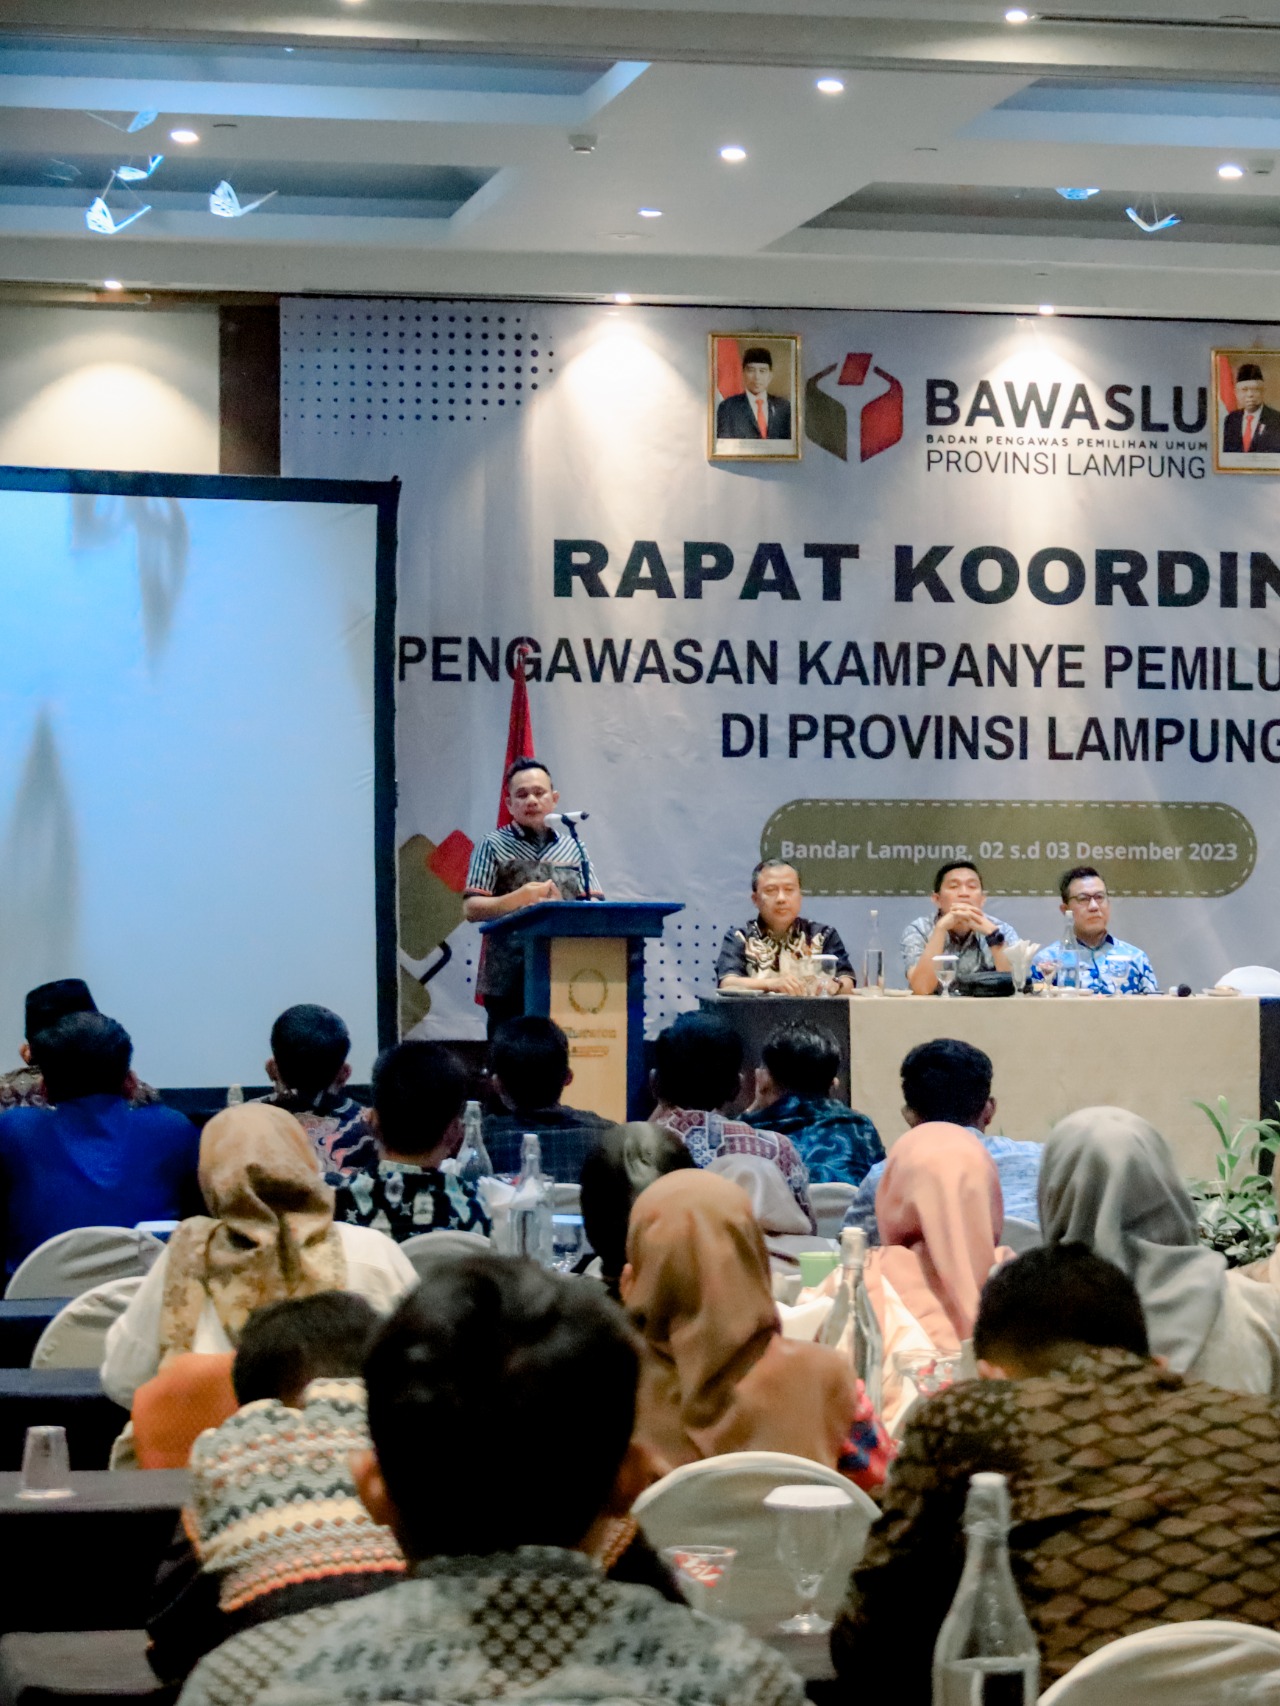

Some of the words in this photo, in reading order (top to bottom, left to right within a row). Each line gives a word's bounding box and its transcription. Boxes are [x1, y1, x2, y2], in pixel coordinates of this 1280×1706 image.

[926, 378, 1208, 433] BAWASLU
[926, 434, 977, 444] BADAN
[986, 436, 1069, 448] PENGAWAS
[1077, 438, 1158, 450] PEMILIHAN
[1165, 441, 1208, 452] UMUM
[926, 450, 1057, 475] PROVINSI
[1067, 453, 1206, 480] LAMPUNG
[553, 538, 860, 601] RAPAT
[399, 635, 778, 684] PENGAWASAN
[798, 640, 1085, 689] KAMPANYE
[721, 713, 769, 759] DI
[787, 713, 1029, 761] PROVINSI
[781, 839, 860, 860] Bandar
[867, 841, 973, 864] Lampung,
[979, 841, 1004, 859] 02
[1010, 841, 1041, 859] s.d
[1046, 842, 1070, 860] 03
[1076, 842, 1183, 860] Desember
[1188, 843, 1238, 861] 2023
